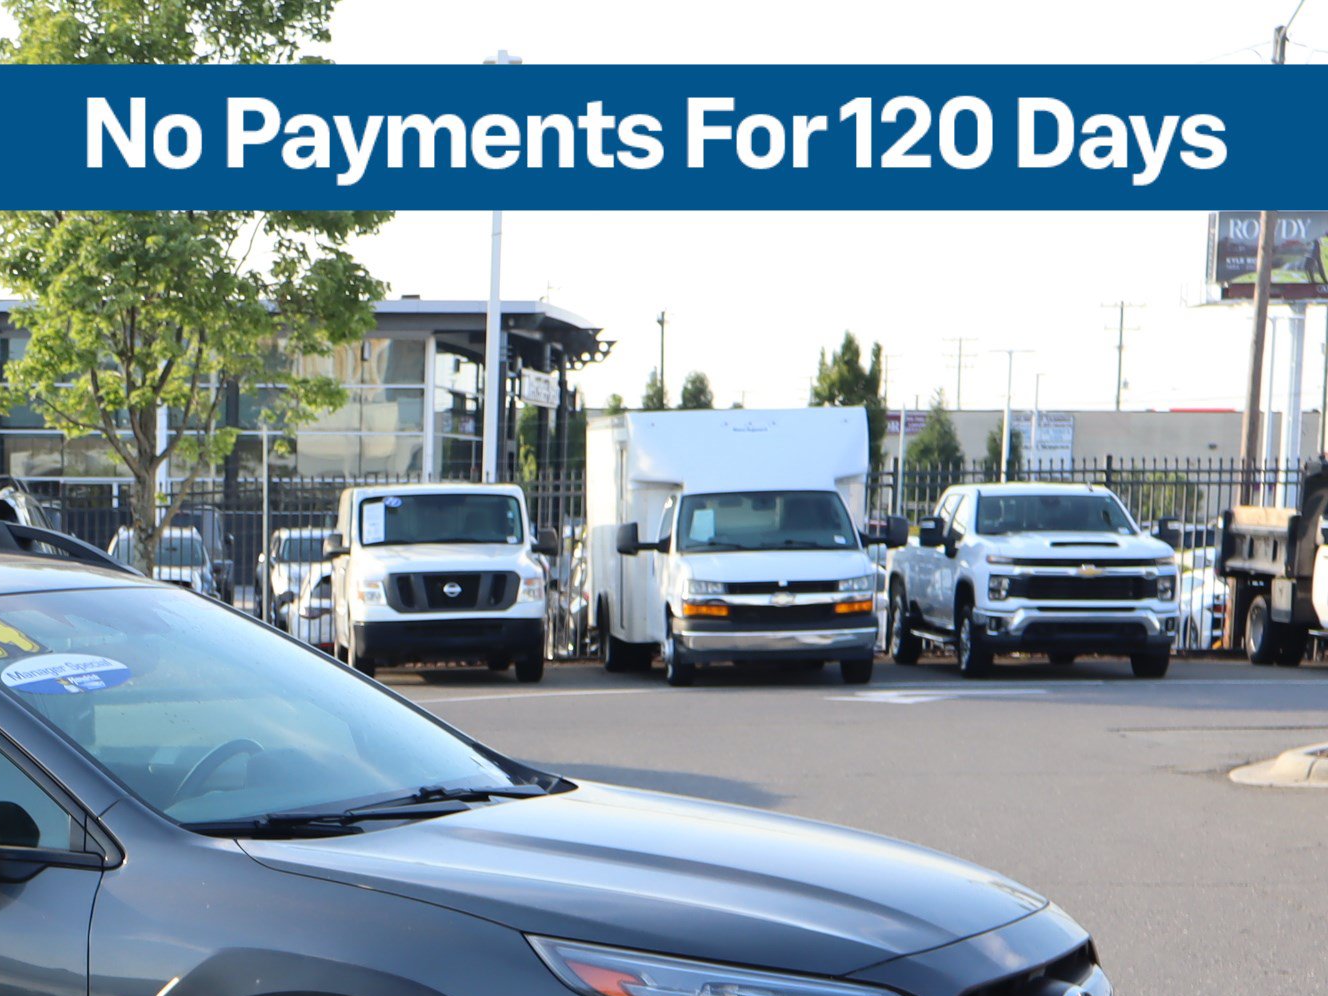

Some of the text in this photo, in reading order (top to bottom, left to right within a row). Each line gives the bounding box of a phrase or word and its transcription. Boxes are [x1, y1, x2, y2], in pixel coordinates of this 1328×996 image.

[1229, 218, 1312, 240] RODY
[6, 657, 113, 682] Manager Special
